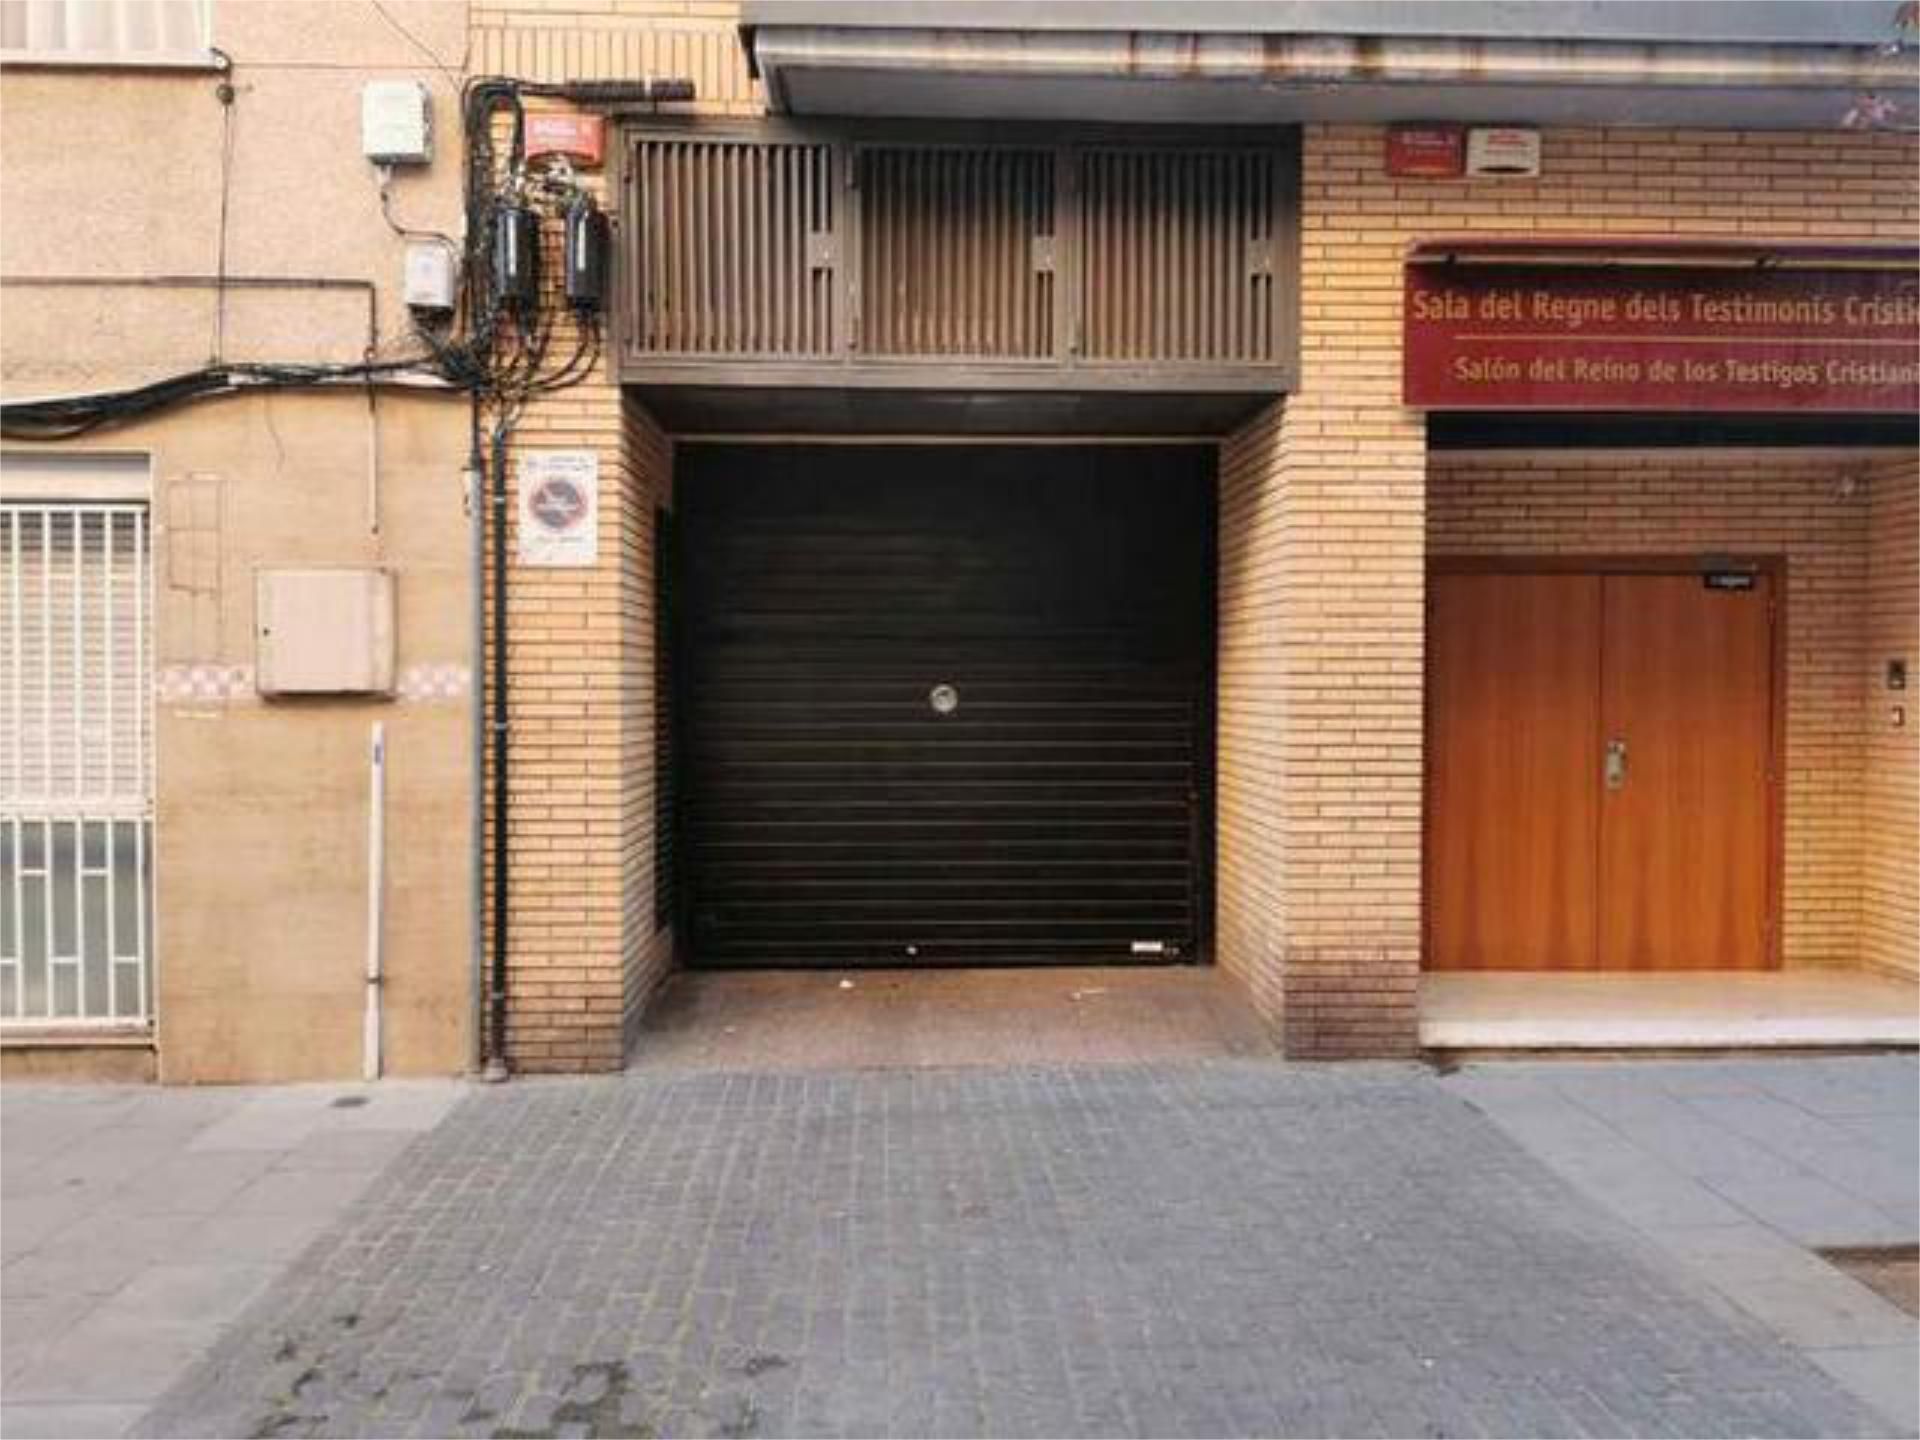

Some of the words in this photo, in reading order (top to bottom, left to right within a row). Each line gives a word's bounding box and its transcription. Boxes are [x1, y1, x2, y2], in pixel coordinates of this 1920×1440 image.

[1412, 290, 1469, 320] Sala
[1480, 290, 1521, 320] del
[1533, 291, 1616, 328] Regne
[1626, 293, 1681, 322] dels
[1691, 292, 1836, 324] Testimonis
[1455, 356, 1520, 380] Salón
[1529, 357, 1566, 381] del
[1574, 357, 1640, 382] Reino
[1649, 359, 1677, 382] de
[1683, 359, 1719, 382] los
[1725, 359, 1819, 388] Testigos
